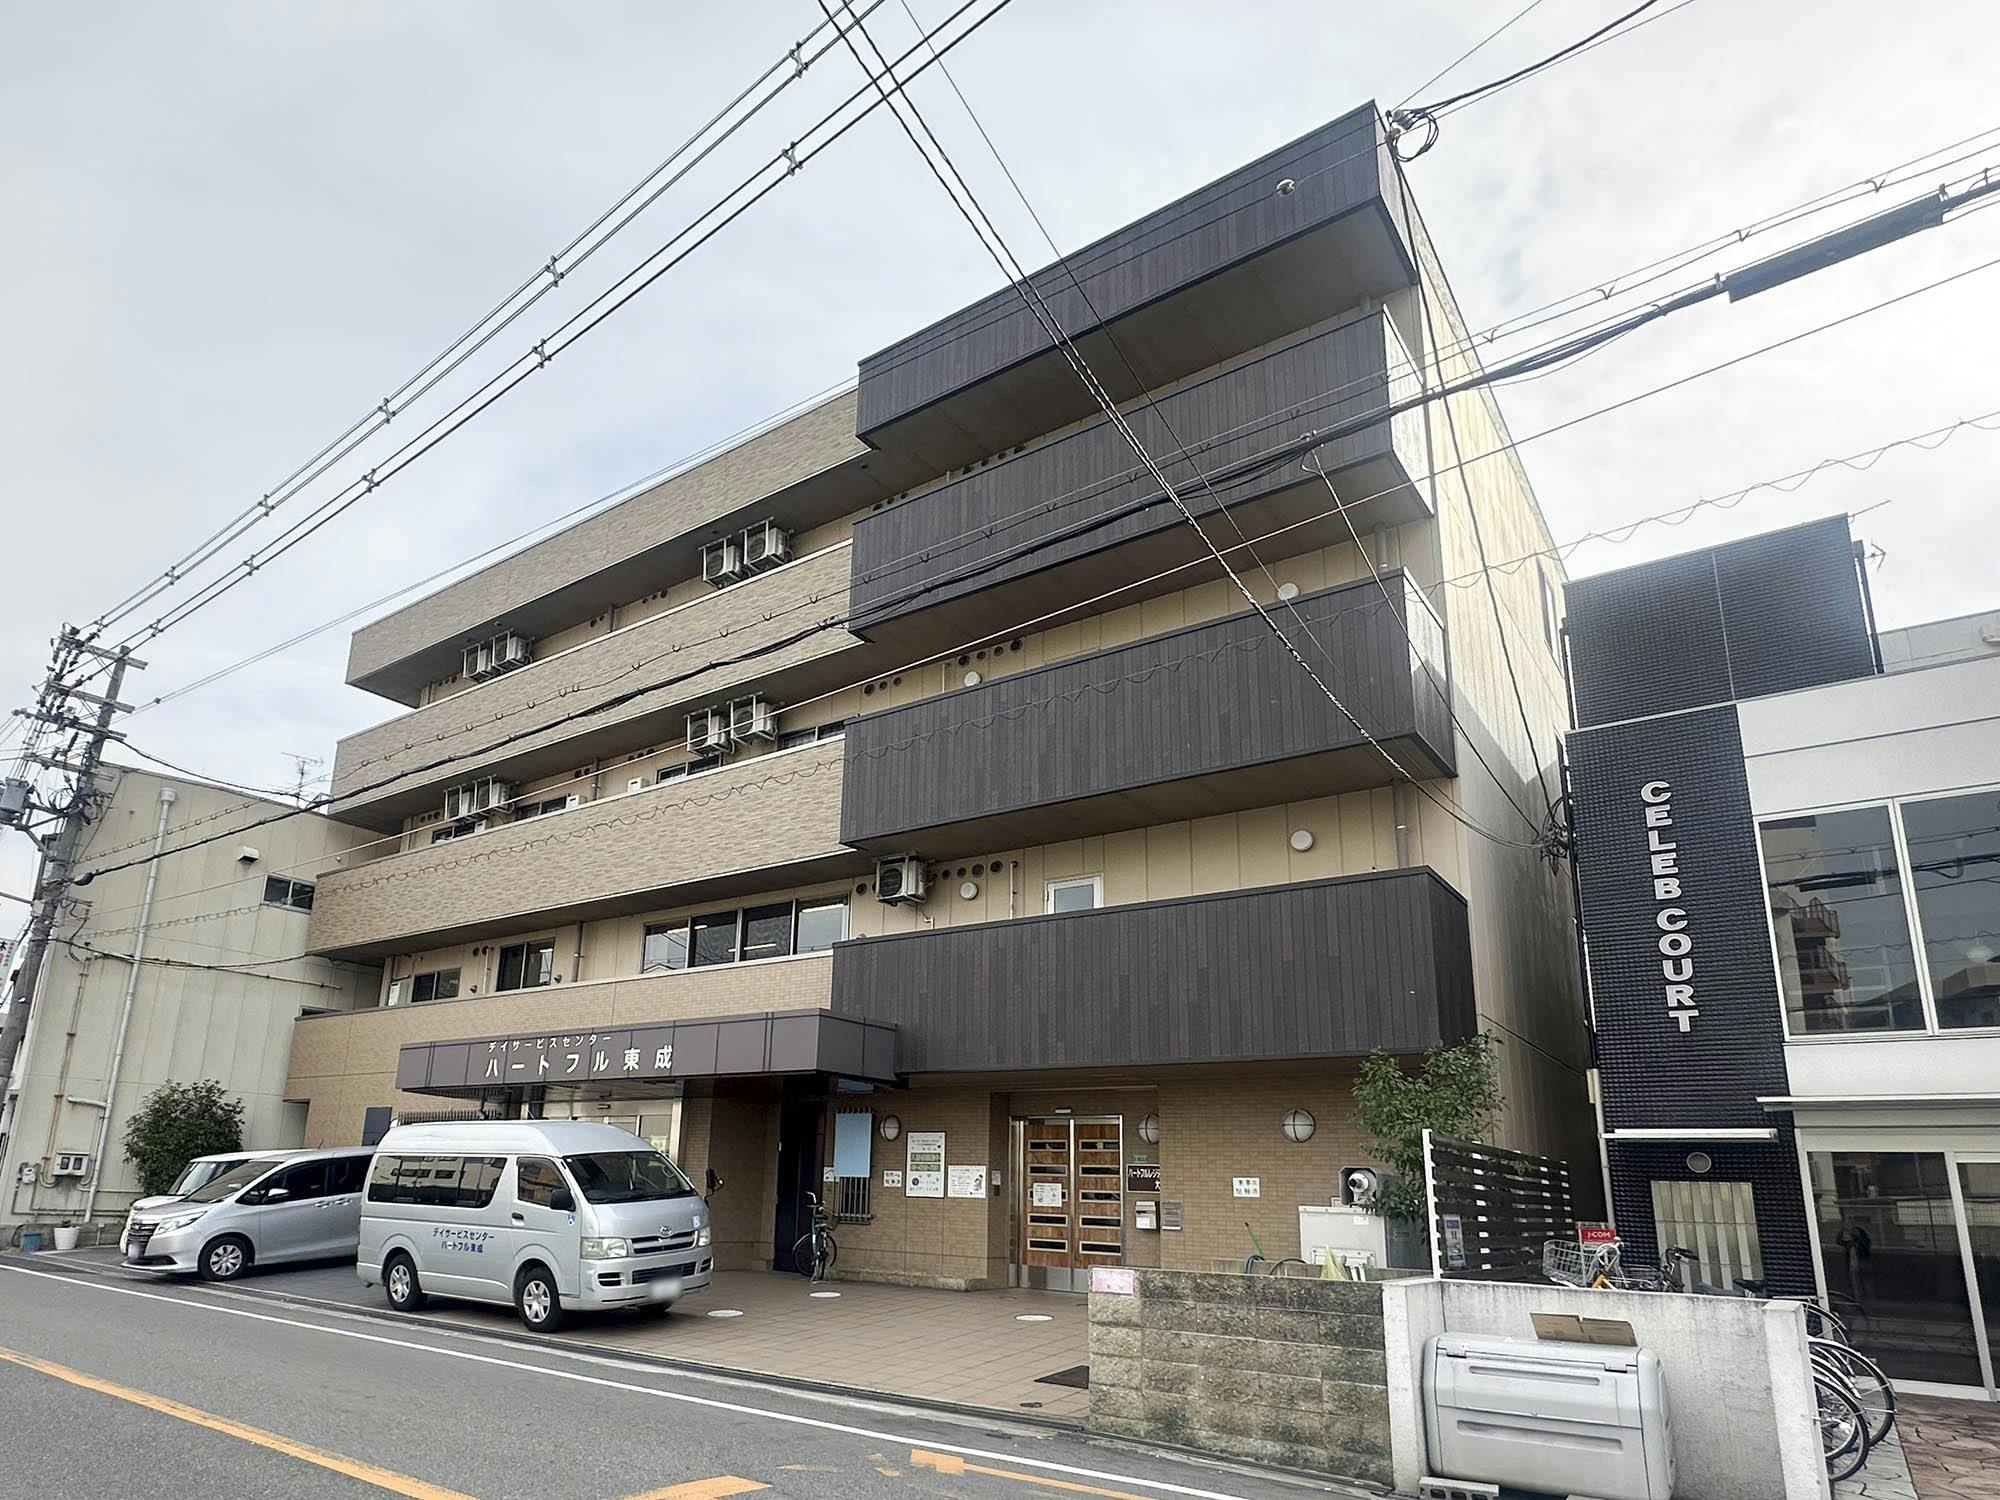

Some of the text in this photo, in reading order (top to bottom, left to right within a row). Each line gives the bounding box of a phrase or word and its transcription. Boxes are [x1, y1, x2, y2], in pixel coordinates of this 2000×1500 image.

[1640, 780, 1699, 1033] CELEB COURT
[488, 1034, 611, 1053] デイサービスセンター
[485, 1045, 673, 1077] ハートフル東成
[433, 1227, 495, 1241] デイサービスセンター
